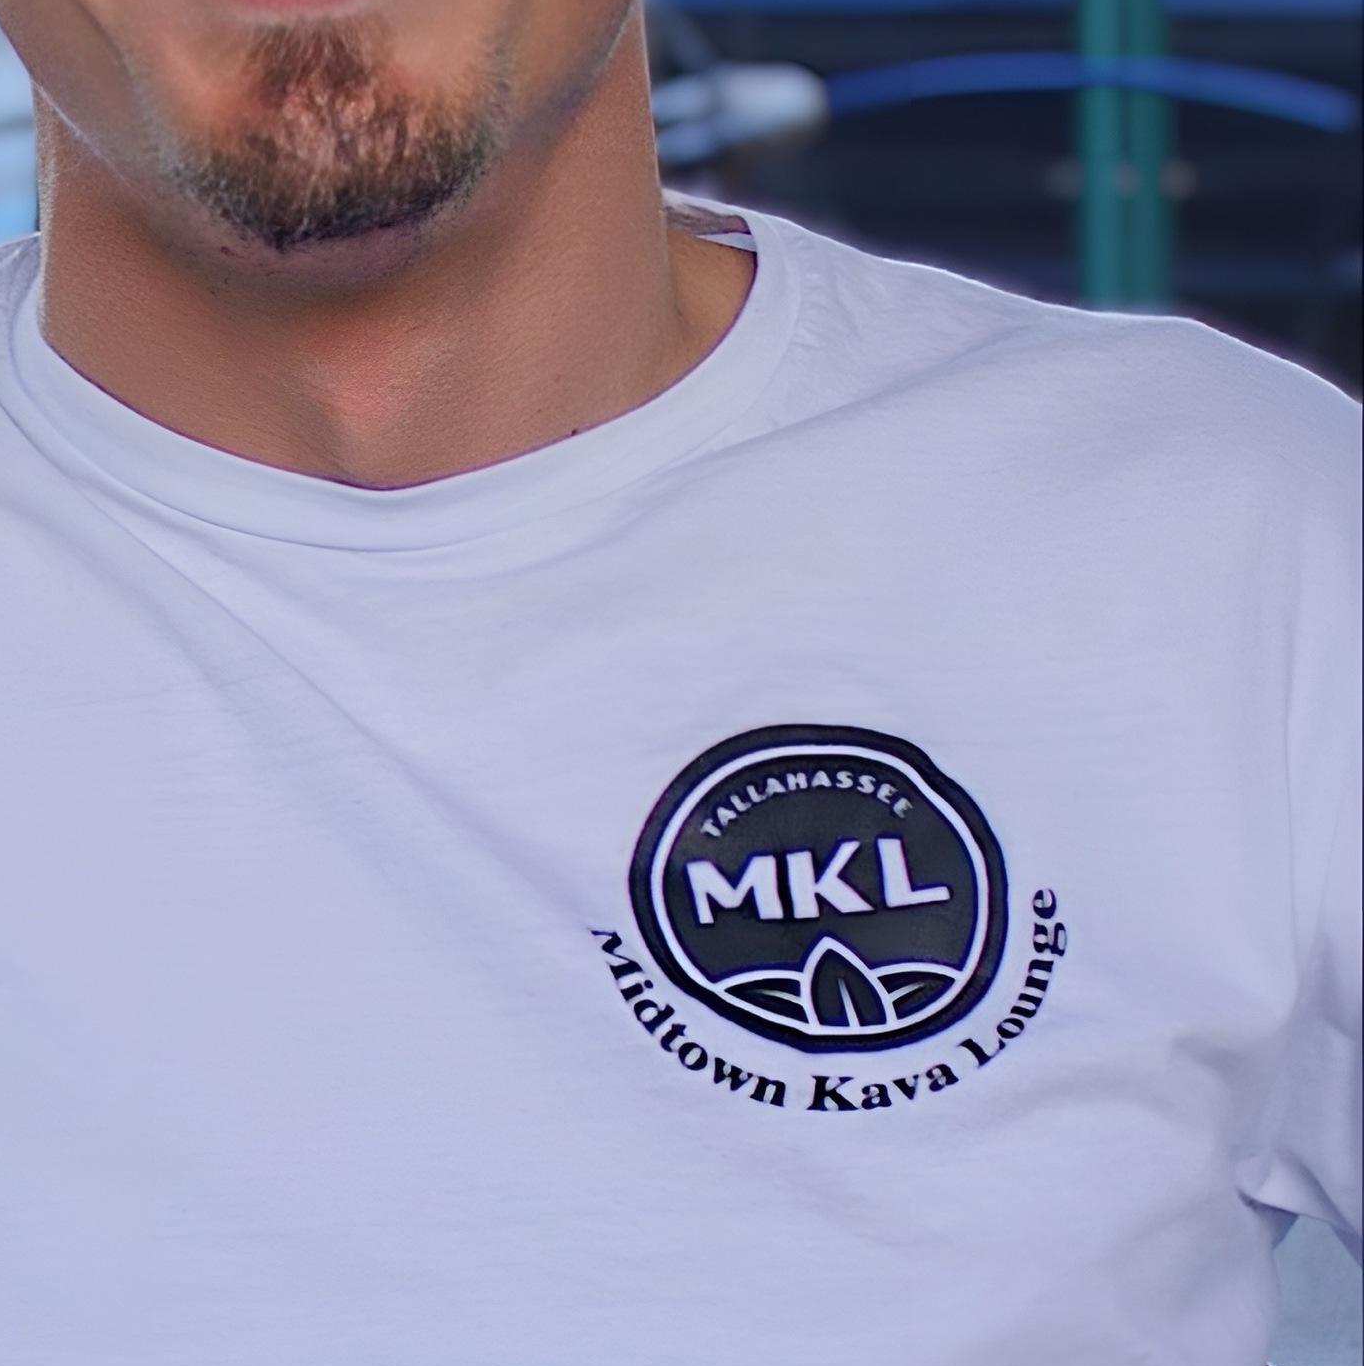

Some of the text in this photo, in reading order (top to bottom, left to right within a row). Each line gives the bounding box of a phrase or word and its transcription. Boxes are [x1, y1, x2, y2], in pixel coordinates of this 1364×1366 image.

[701, 771, 913, 837] TALLAHASSEE
[686, 837, 951, 925] MKL
[589, 888, 1068, 1111] Midtown Kava Lounge
